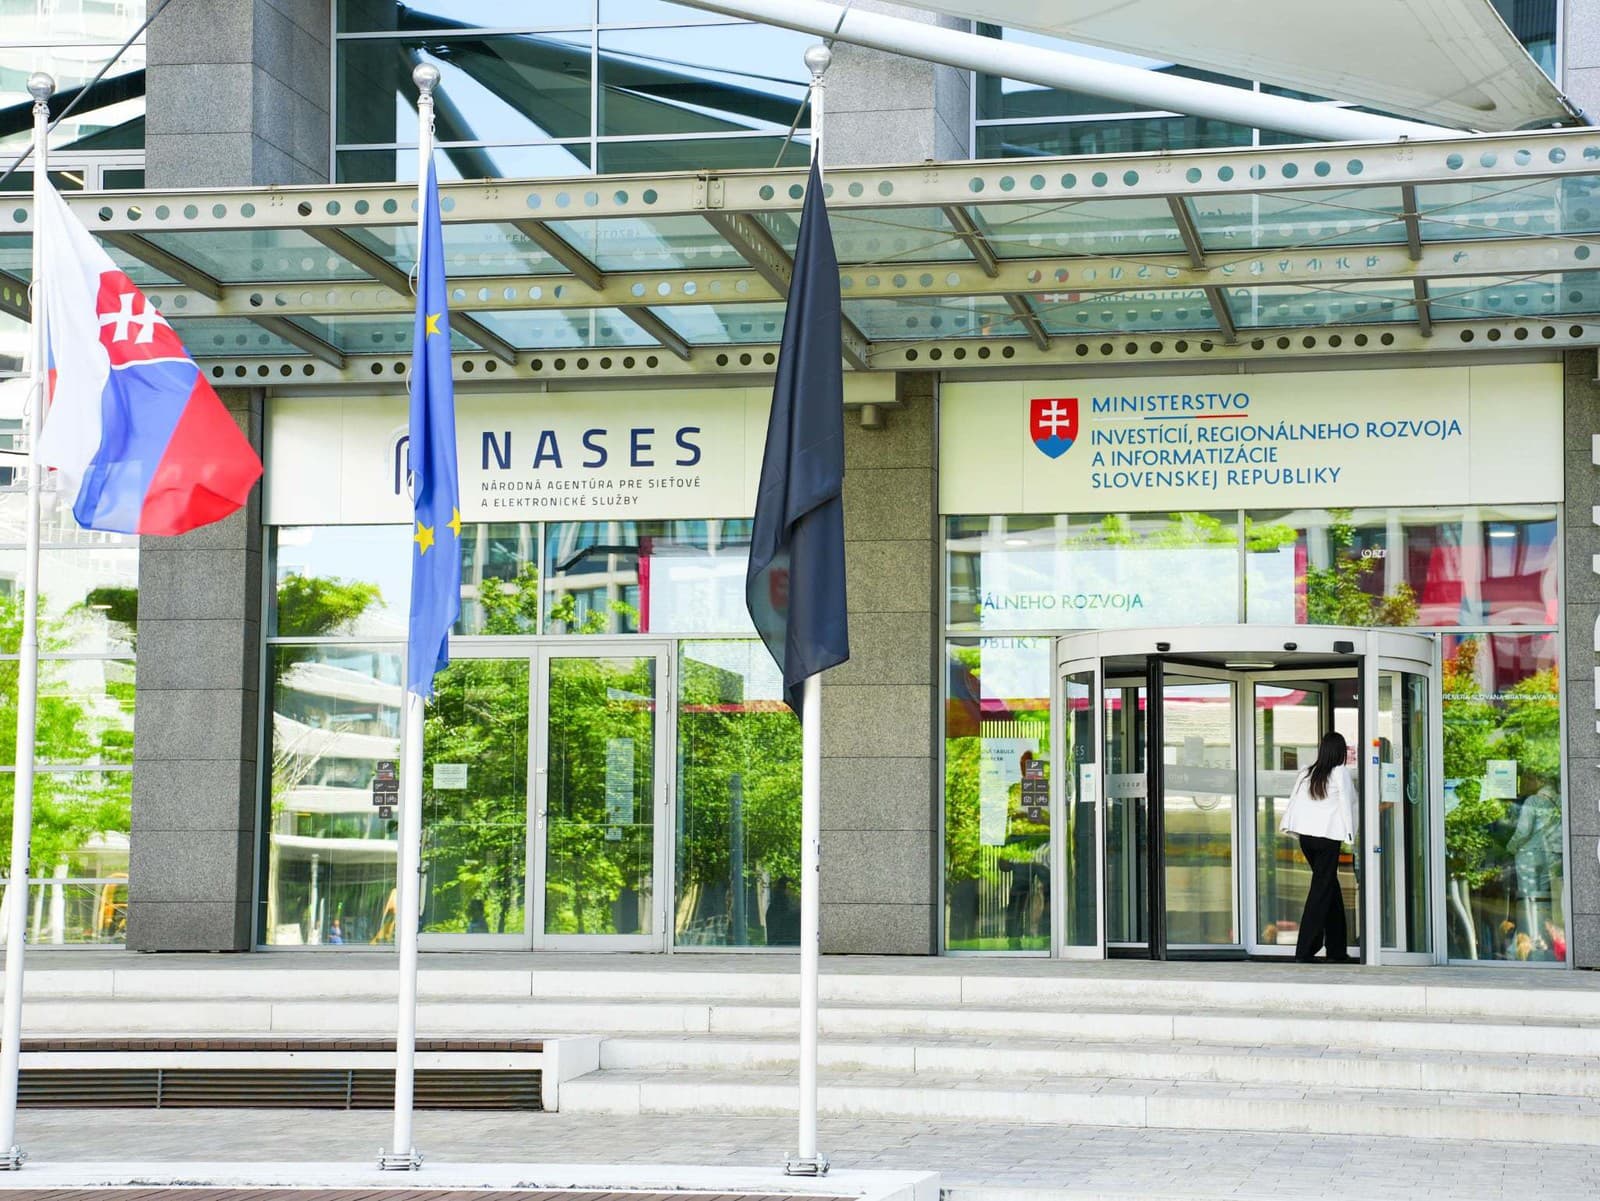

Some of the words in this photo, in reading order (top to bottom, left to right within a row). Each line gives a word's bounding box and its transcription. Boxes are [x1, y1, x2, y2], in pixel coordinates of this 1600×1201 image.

[1092, 393, 1249, 412] MINISTERSTVO
[1091, 424, 1193, 446] INVESTÍCIÍ,
[1197, 420, 1359, 443] REGIONÁLNEHO
[1366, 419, 1462, 440] ROZVOJA
[481, 427, 701, 470] NASES
[1091, 451, 1105, 467] A
[1111, 443, 1278, 465] INFORMATIZÁCIE
[481, 478, 542, 491] NÁRODNÁ
[547, 477, 614, 490] AGENTÚRA
[619, 479, 643, 489] PRE
[648, 476, 701, 489] SIEŤOVÉ
[1091, 472, 1218, 490] SLOVENSKEJ
[1228, 467, 1341, 486] REPUBLIKY
[481, 498, 488, 508] A
[493, 495, 586, 507] ELEKTRONICKÉ
[592, 494, 639, 506] SLUŽBY
[1062, 594, 1144, 612] ROZVOJA
